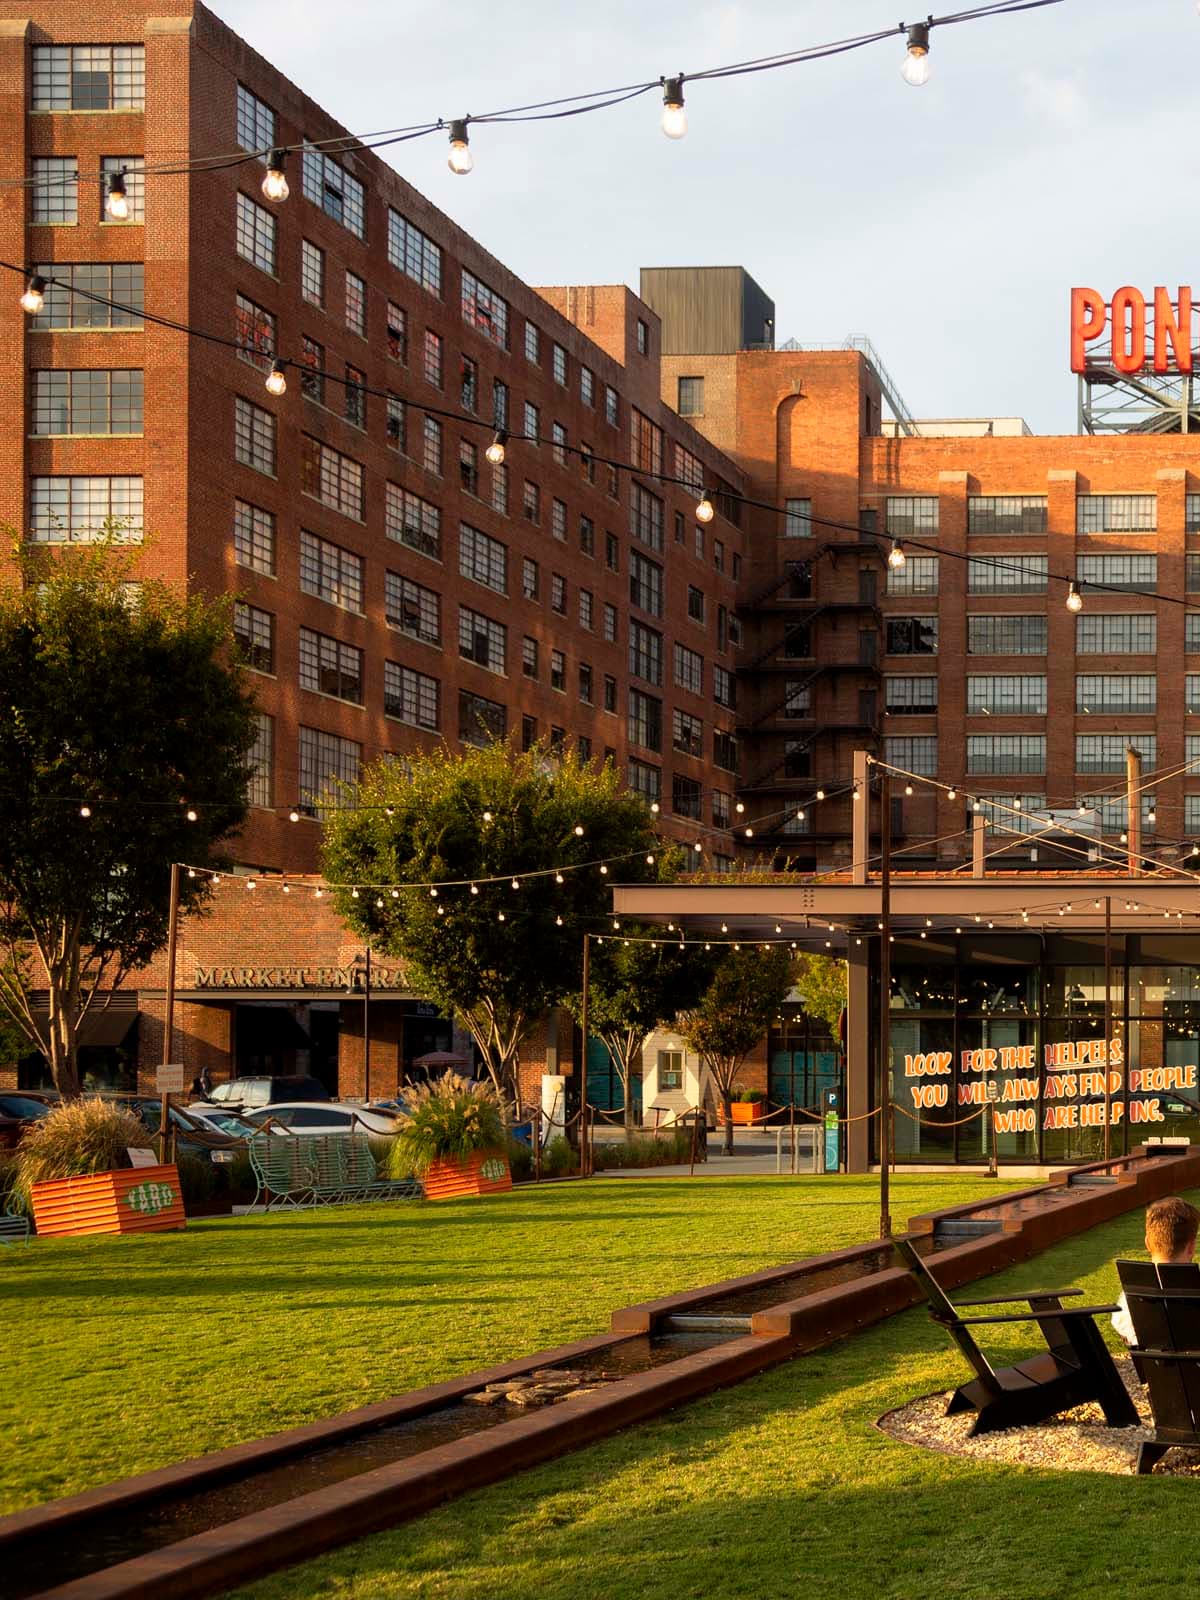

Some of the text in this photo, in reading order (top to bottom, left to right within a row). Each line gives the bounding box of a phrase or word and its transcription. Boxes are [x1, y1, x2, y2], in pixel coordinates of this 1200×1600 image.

[194, 967, 411, 988] MARKET ENTRA
[905, 1052, 952, 1077] LOOK
[961, 1049, 997, 1072] FOR
[999, 1046, 1035, 1070] THE
[829, 1093, 836, 1104] P
[911, 1084, 948, 1108] YOU
[1002, 1074, 1077, 1103] ALWAYS
[1079, 1071, 1121, 1096] FIND
[1130, 1065, 1197, 1092] PEOPLE
[994, 1108, 1036, 1133] WHO
[1043, 1105, 1078, 1130] ARE
